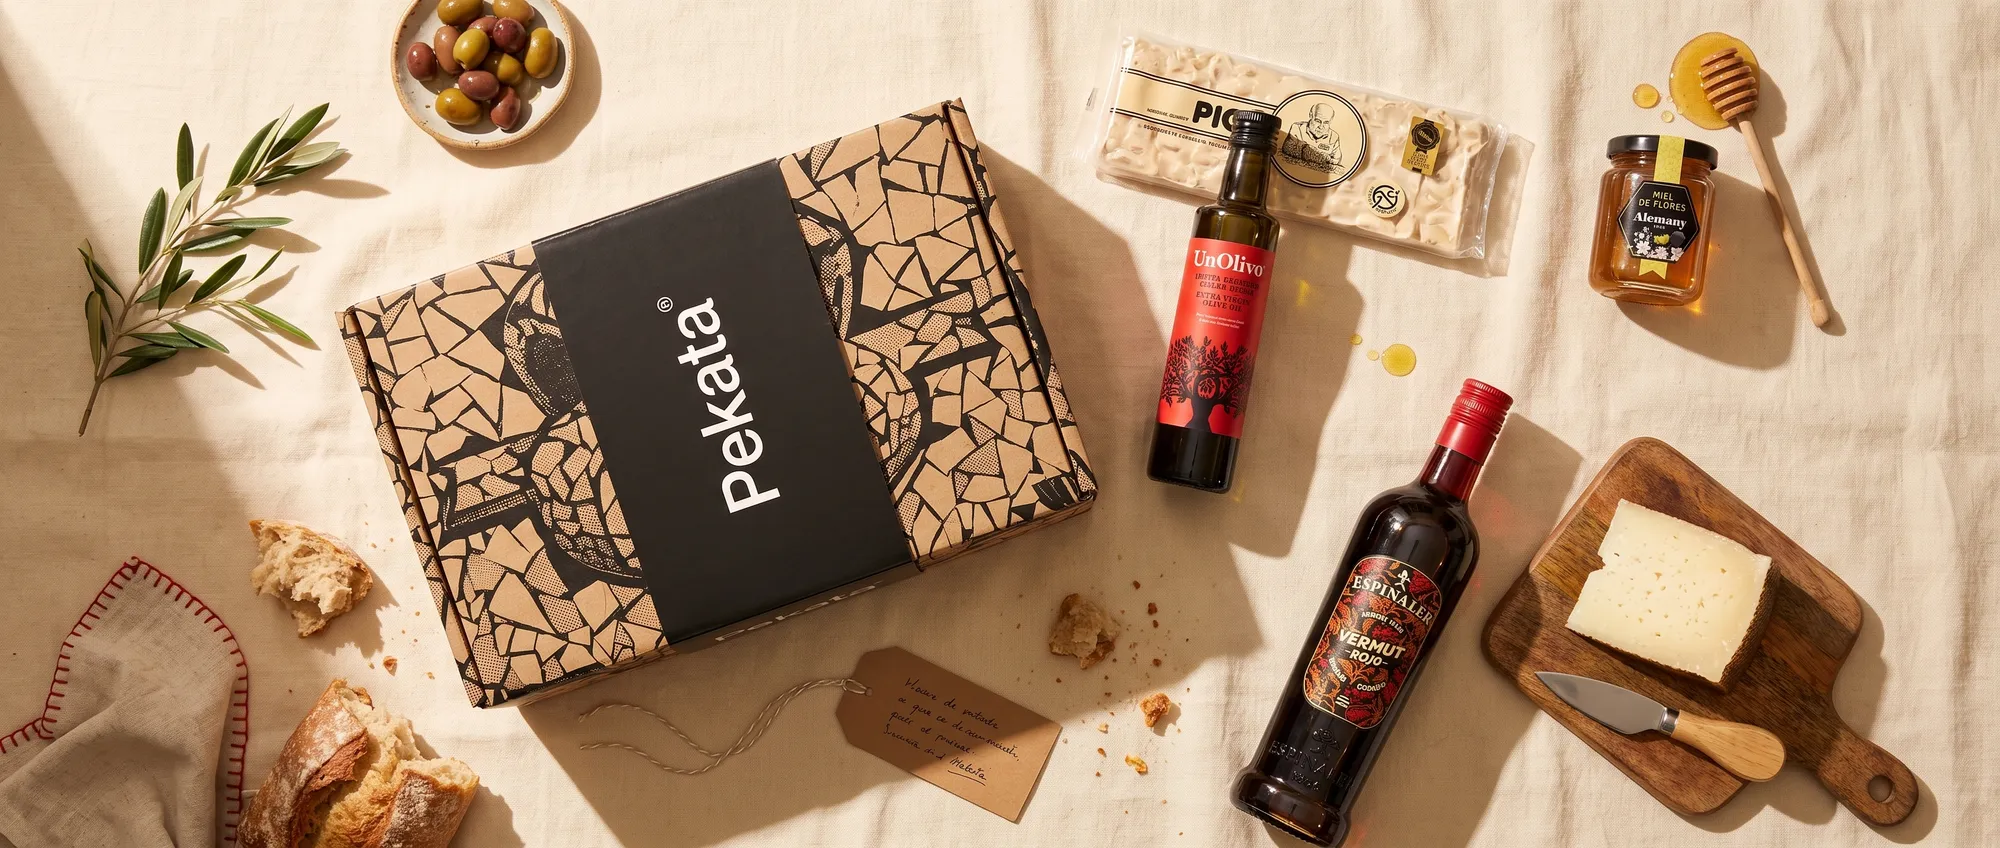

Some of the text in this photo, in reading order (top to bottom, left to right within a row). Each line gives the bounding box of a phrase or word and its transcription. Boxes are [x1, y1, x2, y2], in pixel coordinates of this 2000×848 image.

[1652, 190, 1674, 201] MIEL
[1638, 198, 1686, 212] DE FLORES
[1633, 211, 1687, 230] Alemany
[1202, 299, 1228, 310] OLIVE
[1351, 575, 1434, 626] ESPINALER
[1338, 629, 1406, 660] VERMUT
